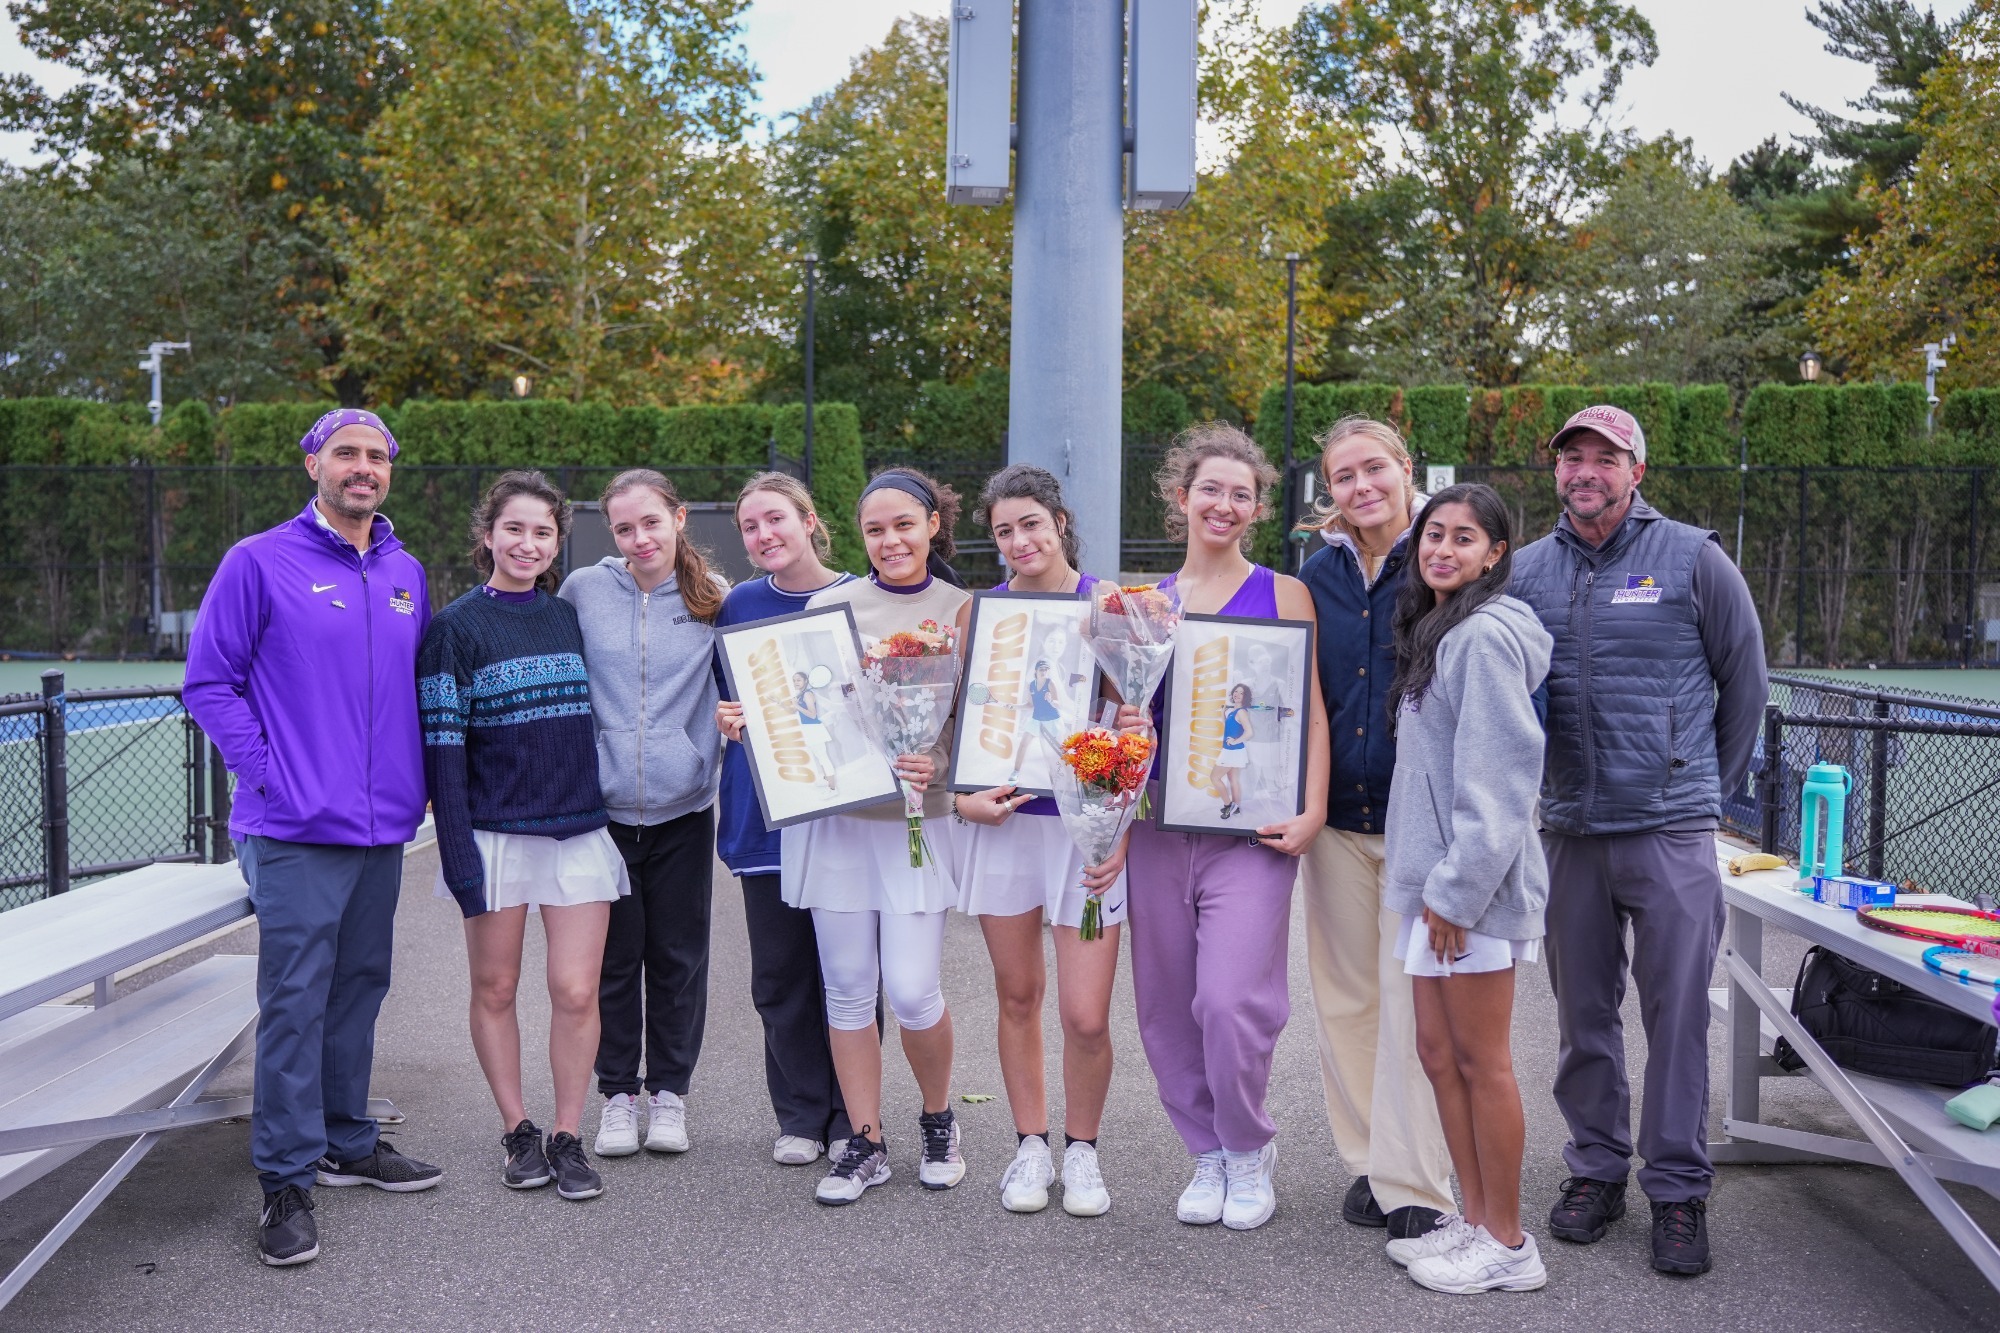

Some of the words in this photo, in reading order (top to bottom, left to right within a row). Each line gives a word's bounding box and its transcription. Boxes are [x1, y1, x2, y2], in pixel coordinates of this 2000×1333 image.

[1435, 475, 1446, 491] 8
[673, 615, 687, 625] LOS
[1616, 589, 1660, 598] HUNTER
[748, 638, 816, 783] CONTRERAS
[979, 612, 1028, 760] CHAPKO
[1187, 635, 1229, 799] SCHONFELD
